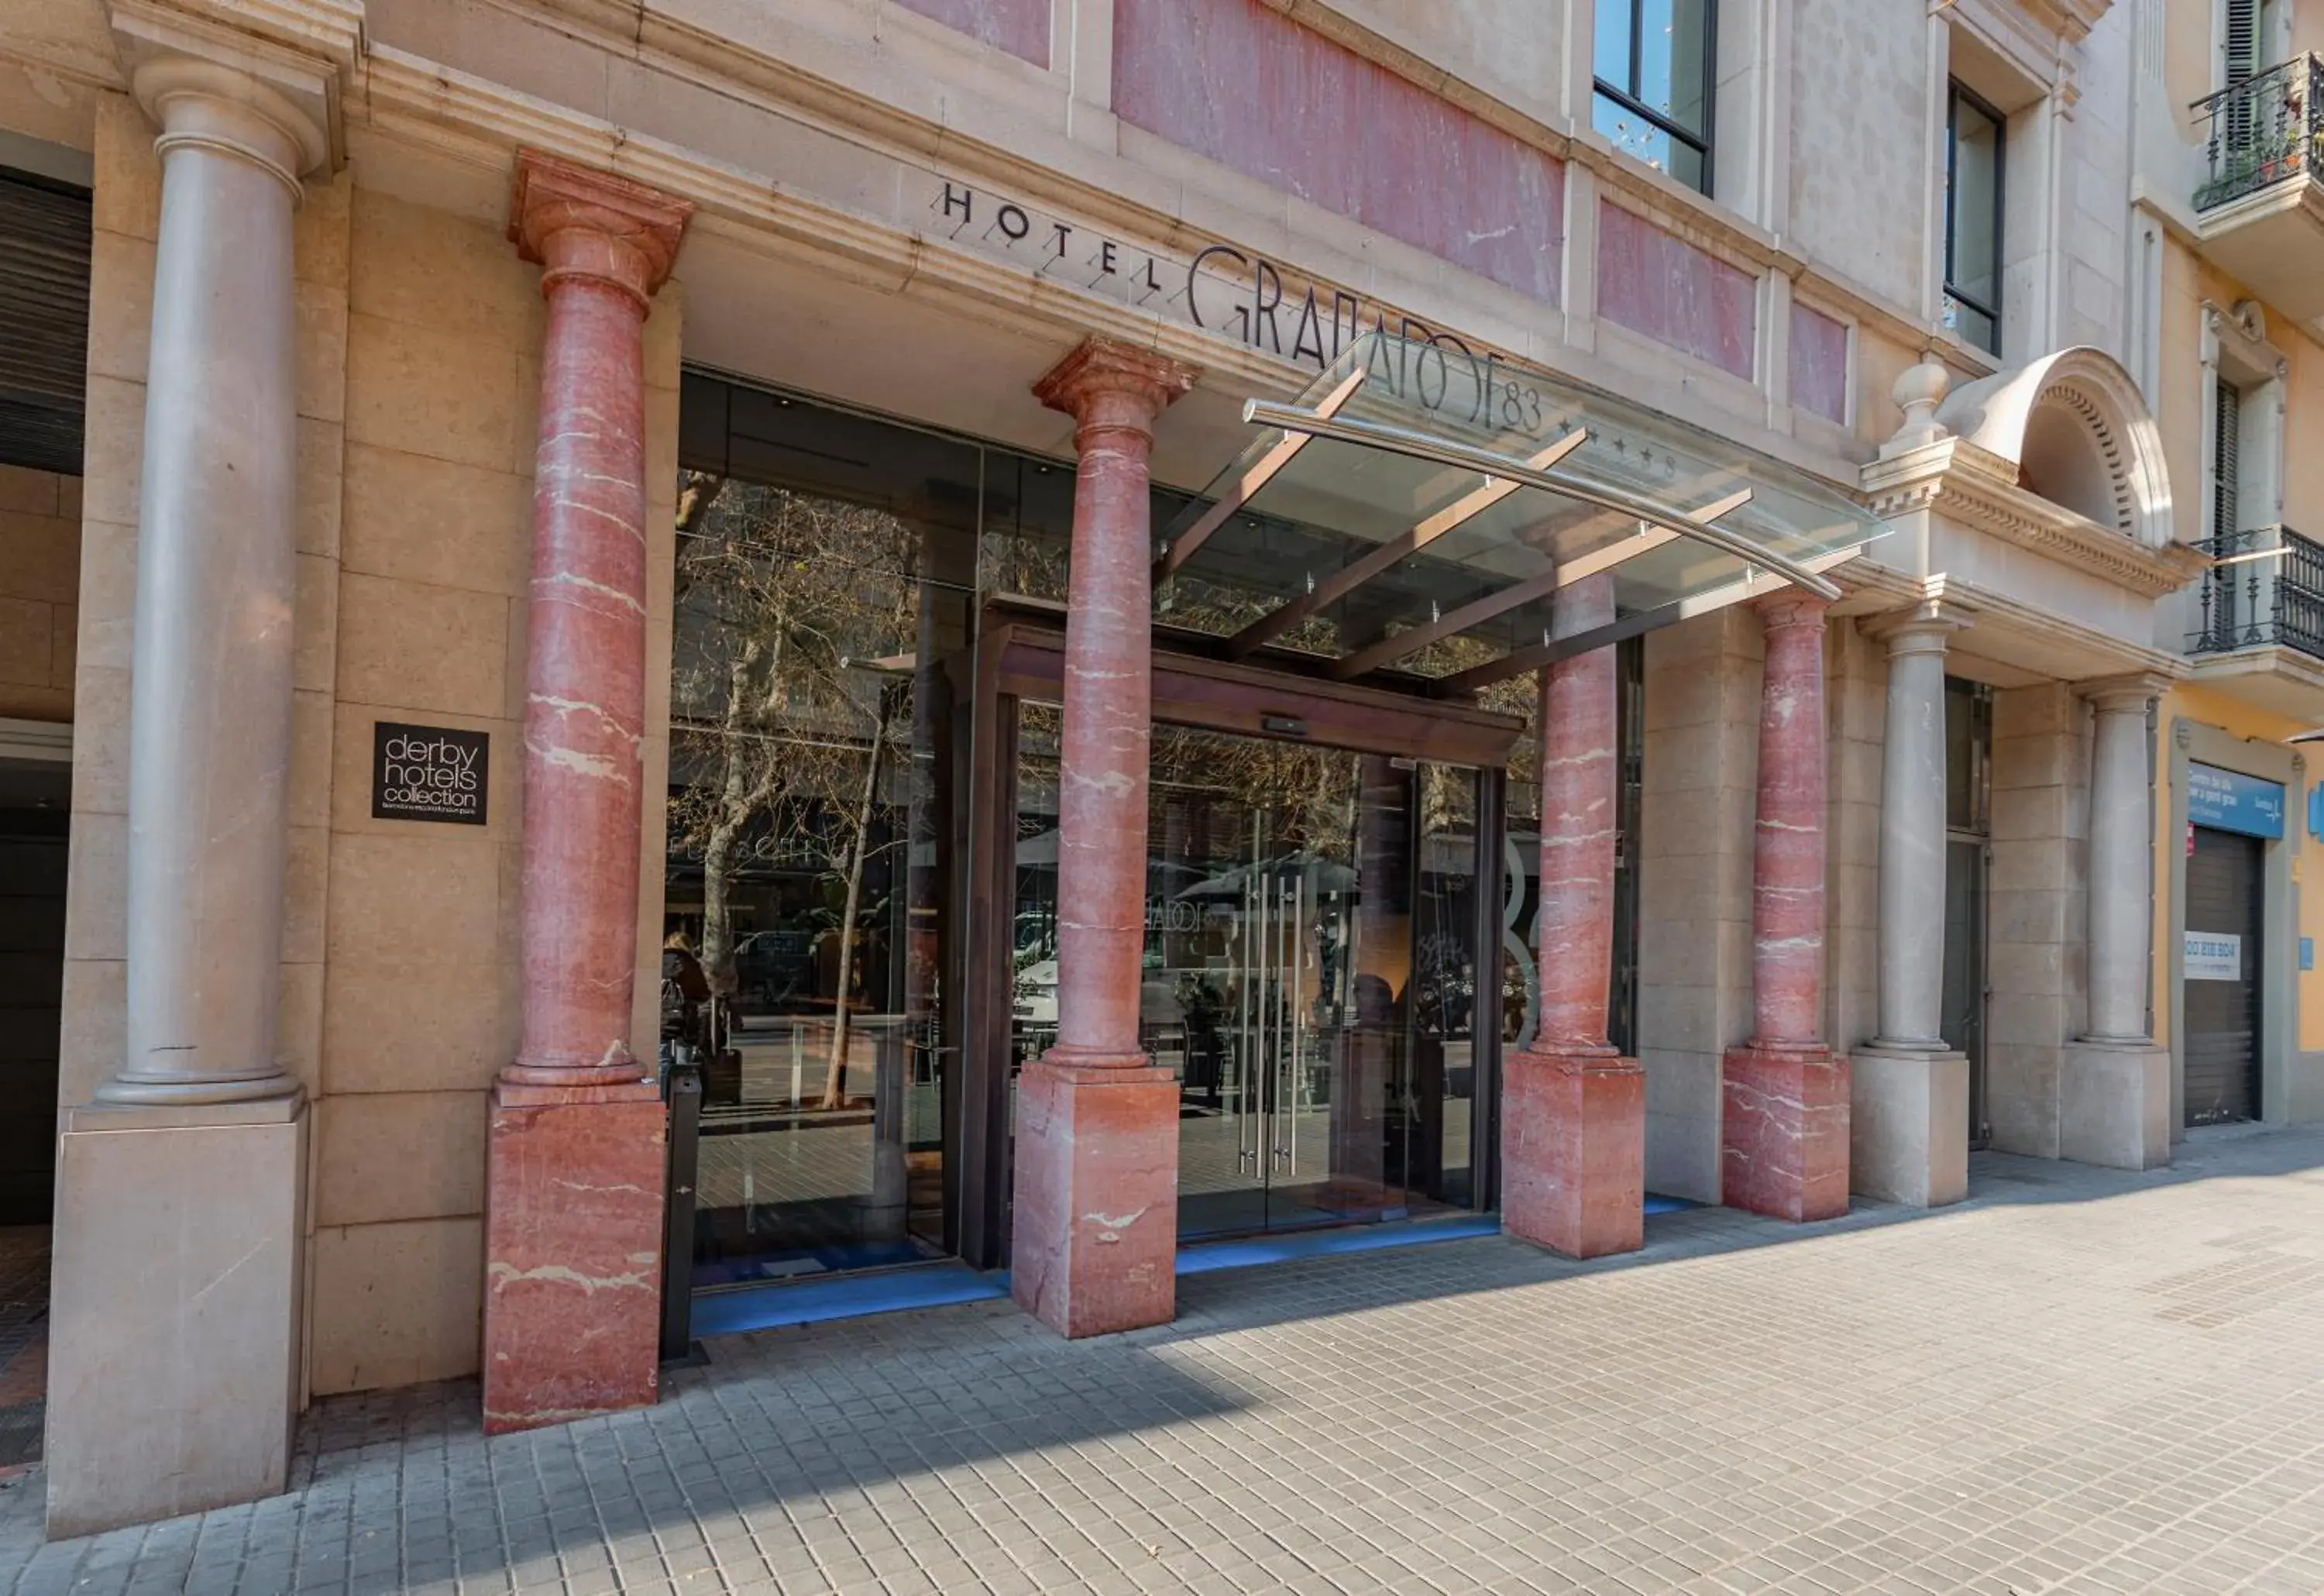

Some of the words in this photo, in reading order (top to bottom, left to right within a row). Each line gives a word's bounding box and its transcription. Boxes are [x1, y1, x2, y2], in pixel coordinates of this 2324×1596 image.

[944, 183, 1161, 291] HOTEL
[1502, 380, 1542, 432] 83
[385, 734, 478, 771] derby
[385, 757, 477, 791] hotels
[383, 783, 476, 807] collection
